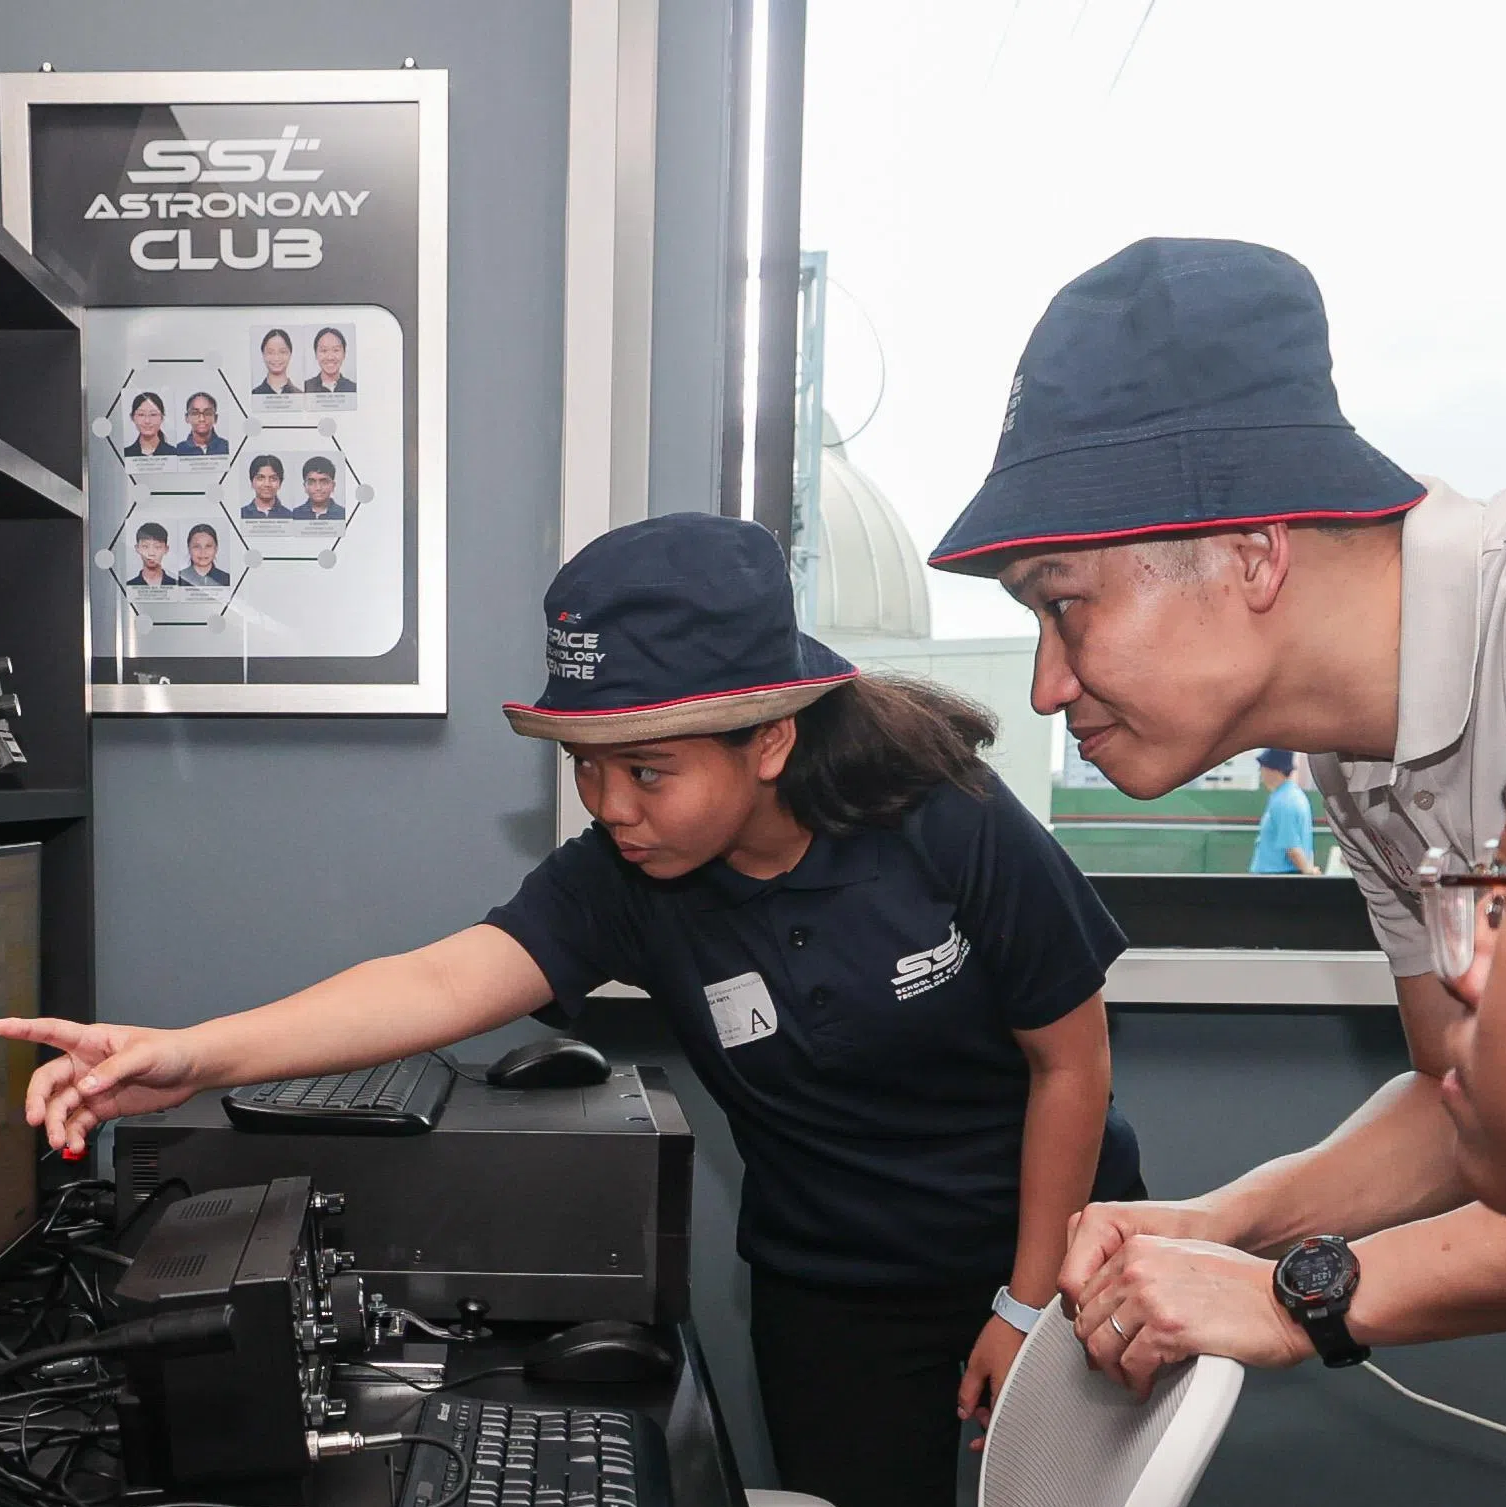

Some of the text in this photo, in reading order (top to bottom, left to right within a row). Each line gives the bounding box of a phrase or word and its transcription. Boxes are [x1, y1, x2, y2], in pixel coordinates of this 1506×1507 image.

[84, 191, 370, 219] ASTRONOMY
[130, 228, 323, 271] CLUB
[895, 971, 945, 996] SCHOOL OF
[751, 1007, 773, 1035] A
